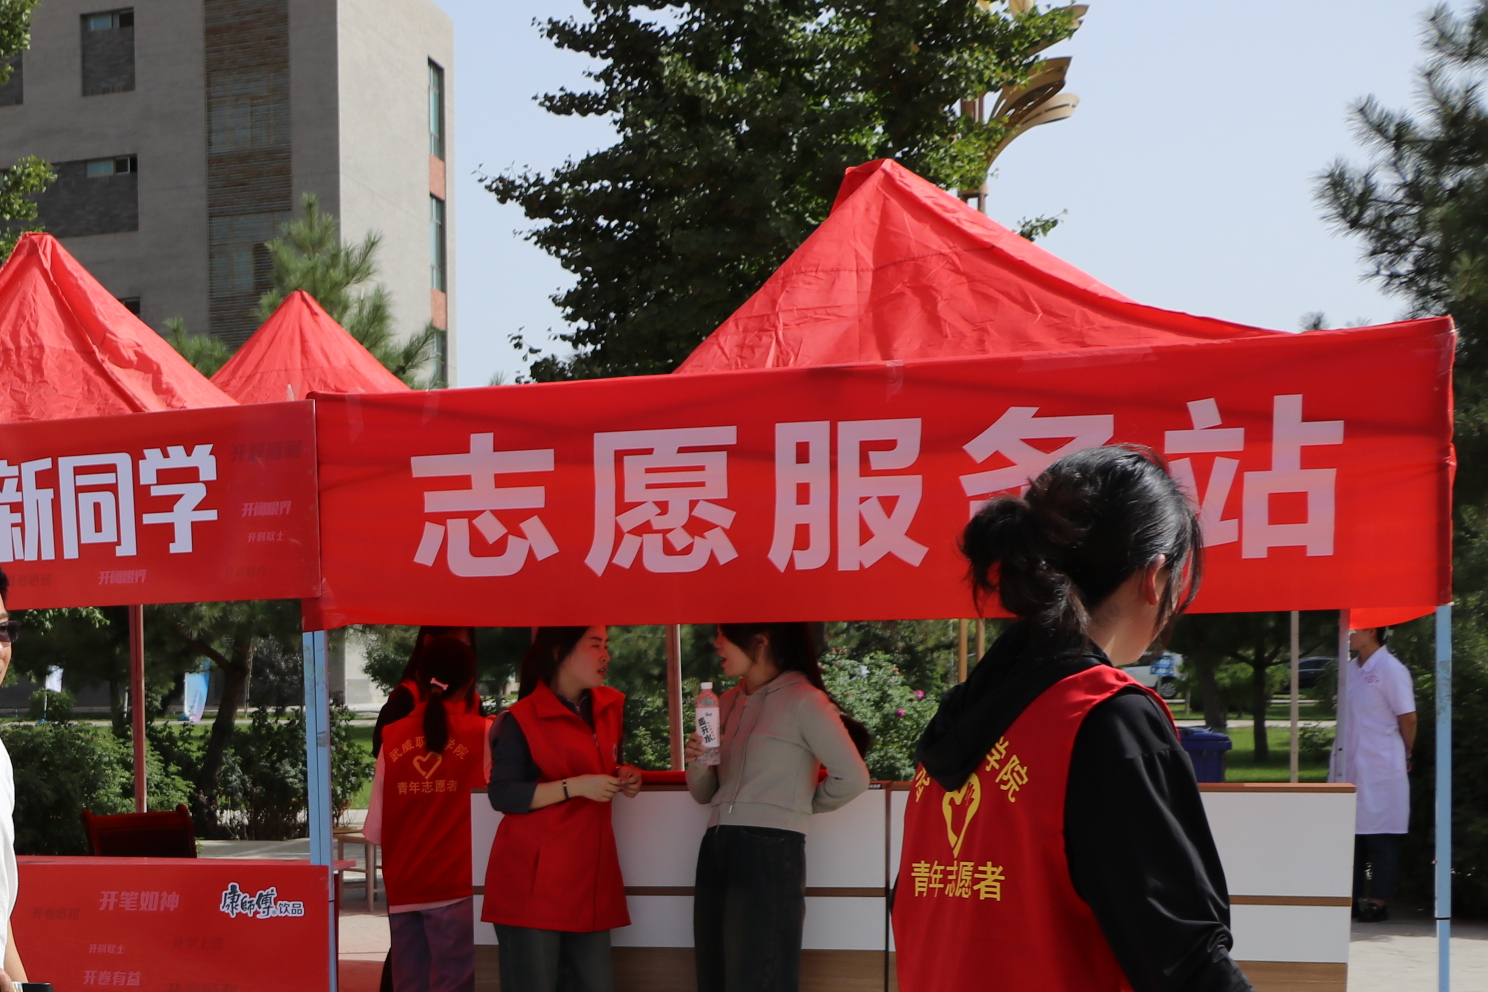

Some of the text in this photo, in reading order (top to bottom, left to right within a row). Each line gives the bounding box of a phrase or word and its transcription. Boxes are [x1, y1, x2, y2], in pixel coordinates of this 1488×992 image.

[389, 736, 469, 762] 武威职学院
[397, 779, 458, 795] 青年志愿者
[911, 860, 1005, 901] 青年志愿者
[99, 890, 180, 912] 开笔如神
[83, 970, 142, 987] 开卷有益
